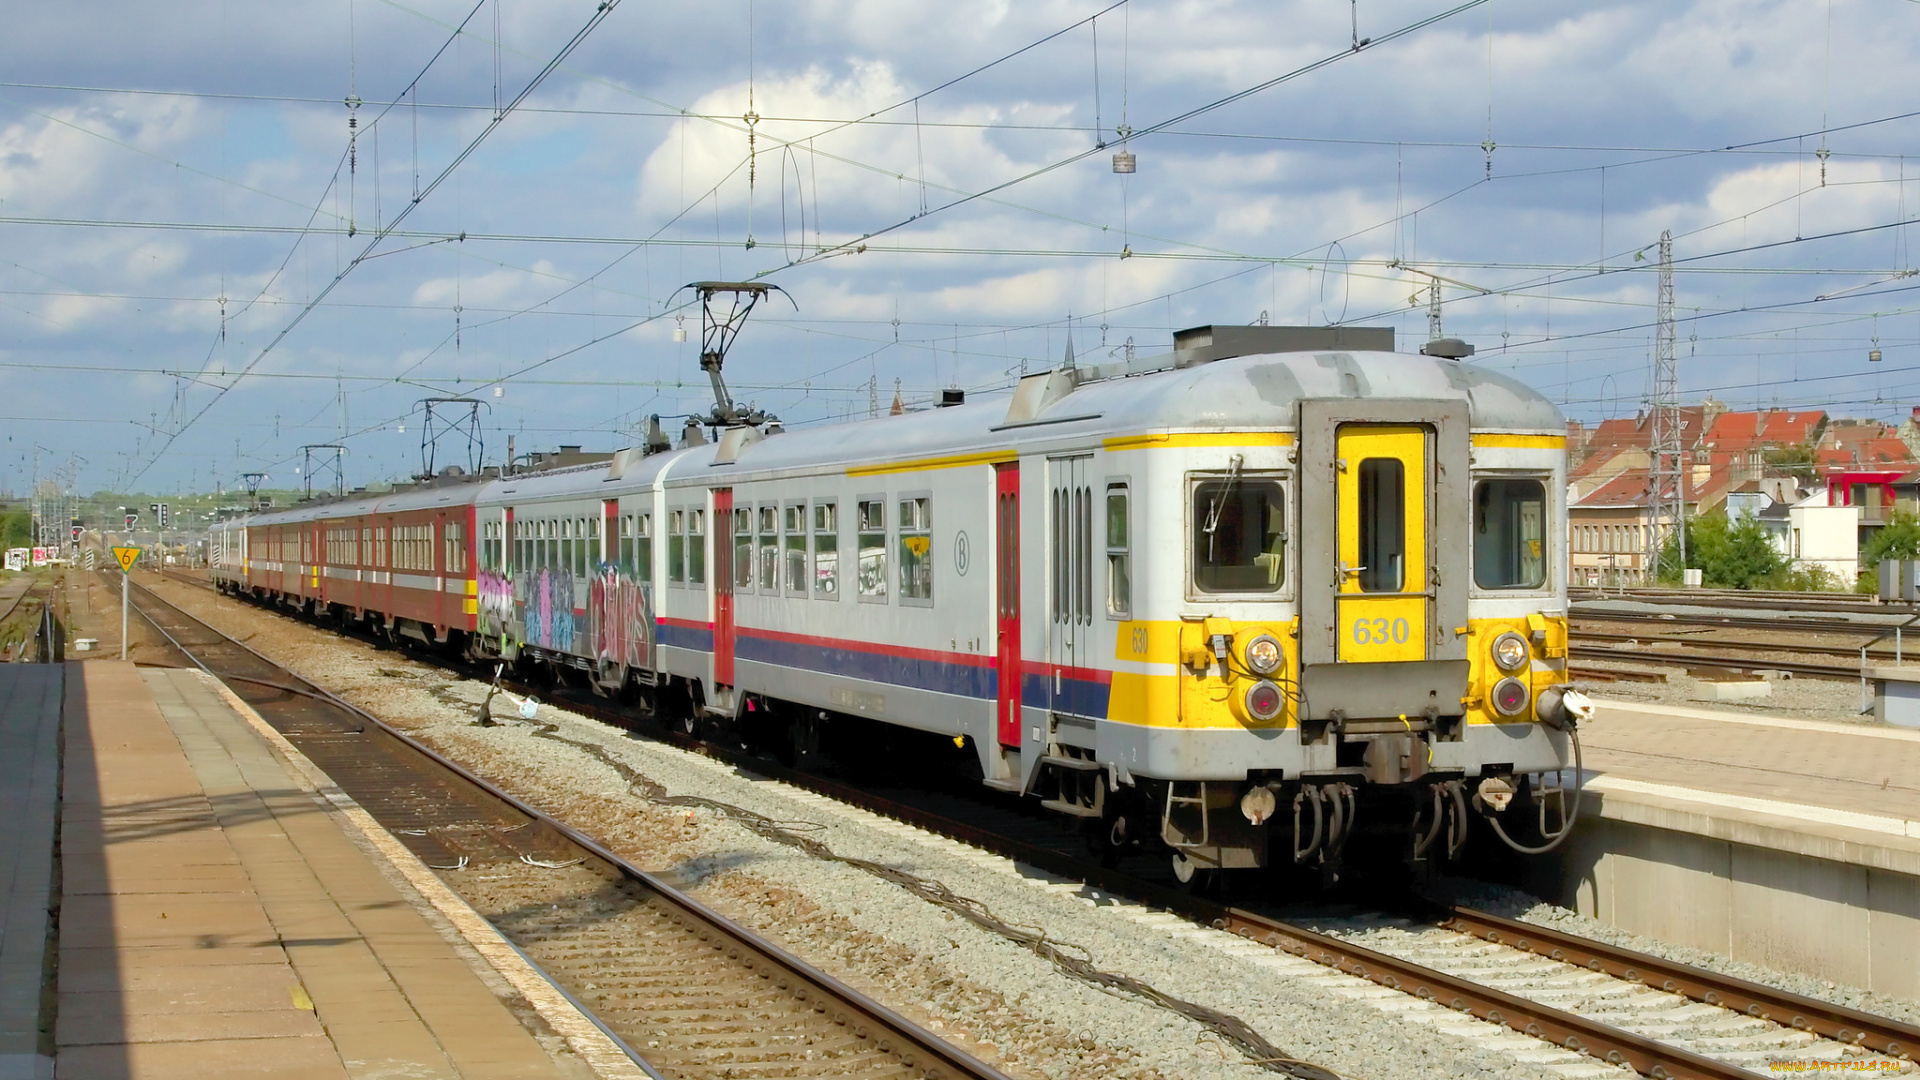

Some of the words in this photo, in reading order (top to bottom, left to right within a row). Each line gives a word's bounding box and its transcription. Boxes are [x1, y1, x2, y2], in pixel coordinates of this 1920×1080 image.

[121, 549, 131, 565] 6
[1132, 627, 1149, 654] 630
[1353, 617, 1409, 645] 630
